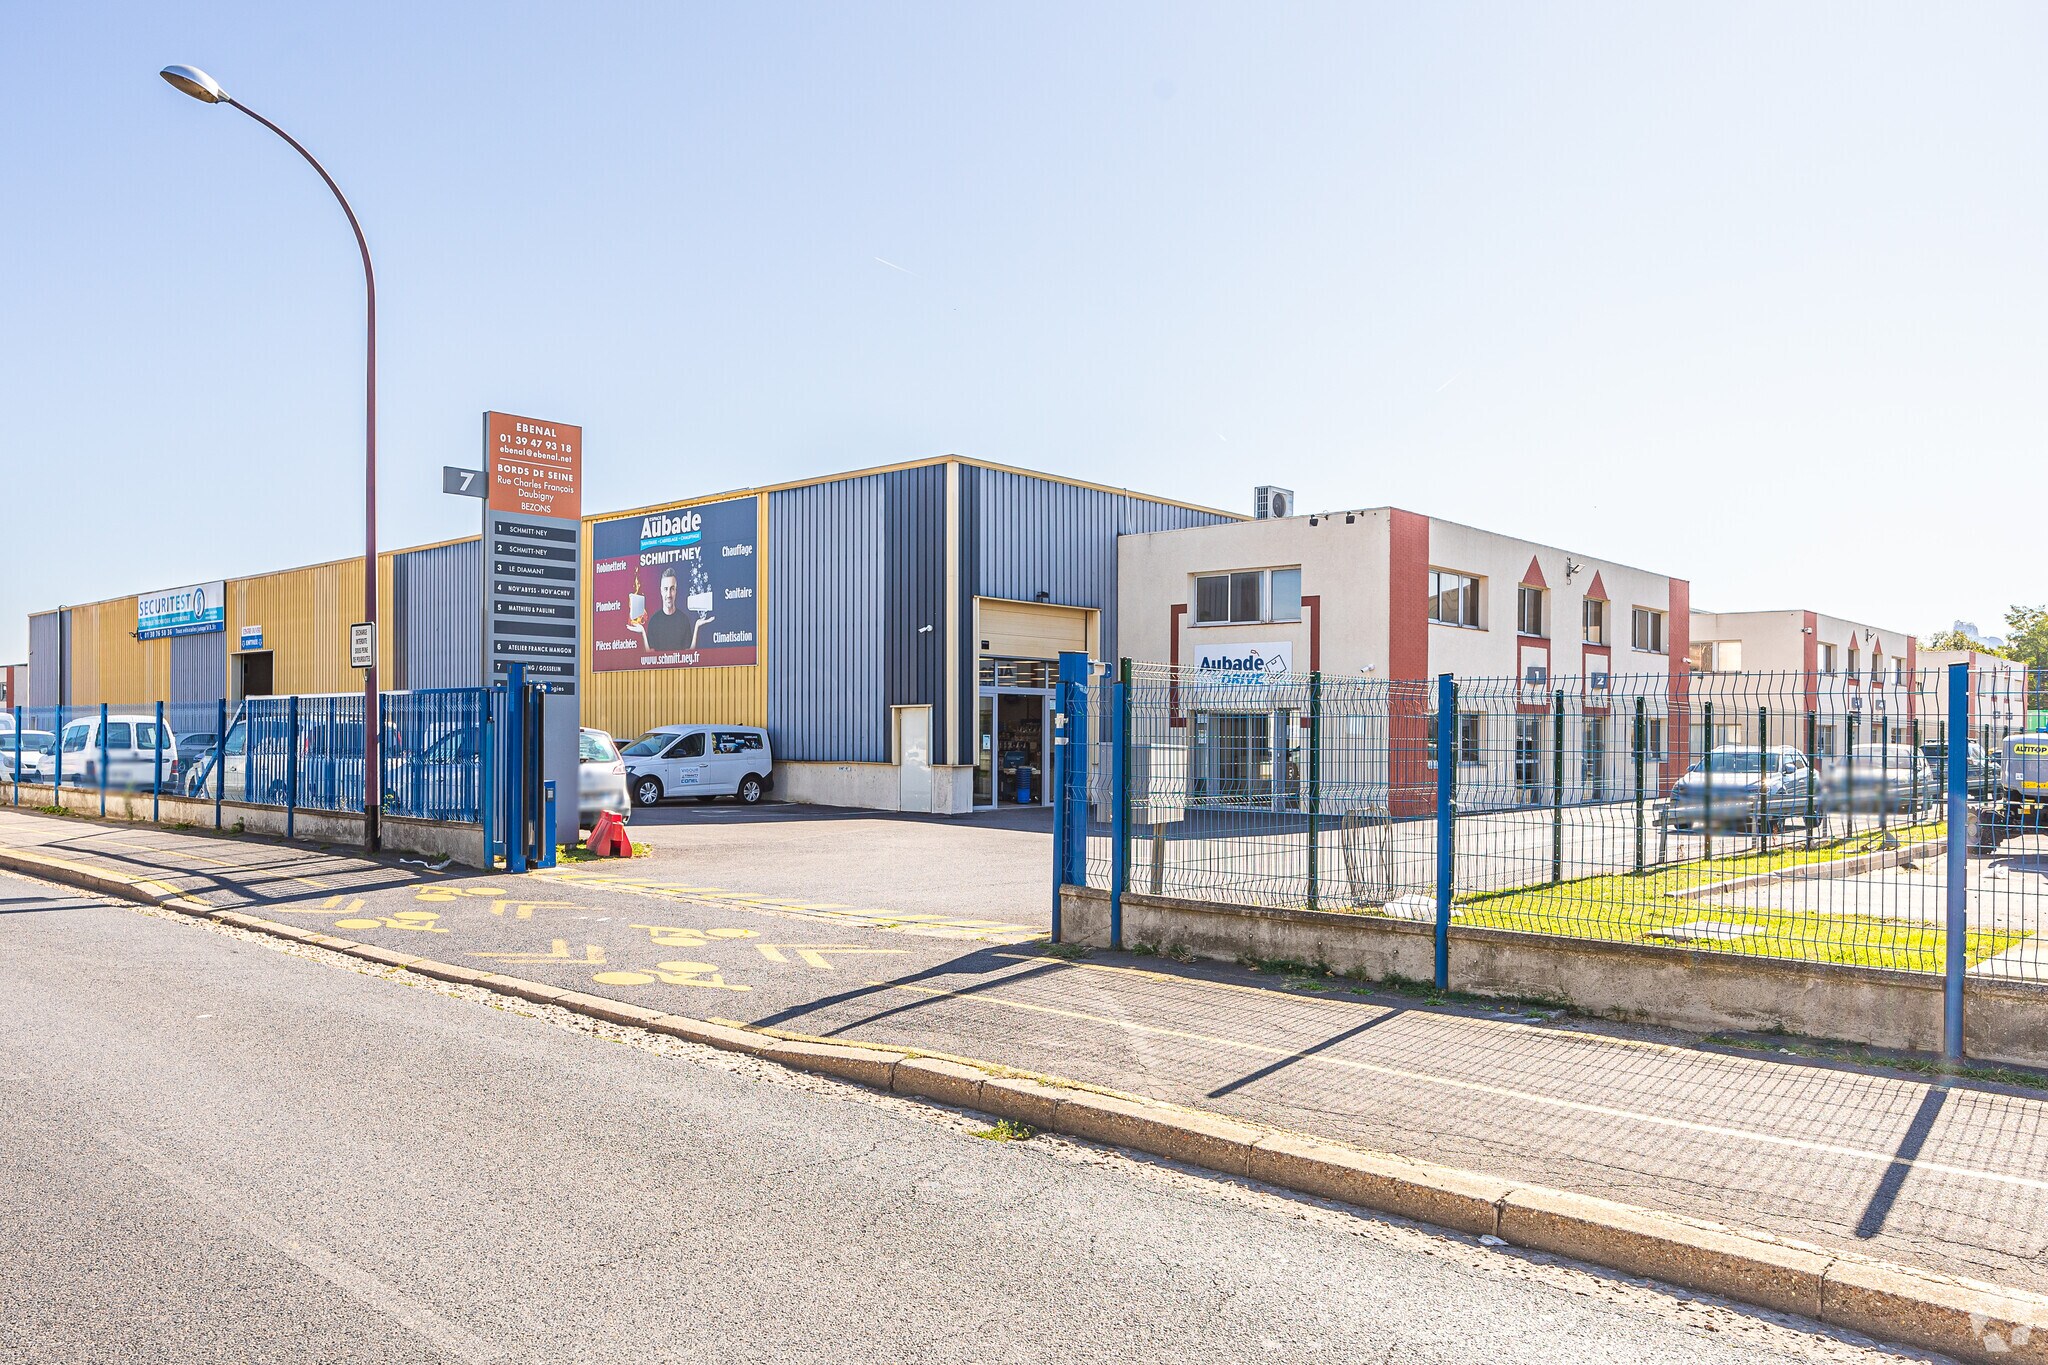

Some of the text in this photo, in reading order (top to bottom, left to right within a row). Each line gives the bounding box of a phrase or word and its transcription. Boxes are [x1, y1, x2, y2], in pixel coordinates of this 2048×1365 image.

[516, 422, 556, 437] EBENAL
[500, 434, 572, 452] 01 39 47 93 18
[500, 445, 572, 462] ebenal@ebenal.net
[498, 464, 573, 481] BORDS DE SEINE
[460, 472, 475, 492] 7
[498, 475, 574, 494] Rue Charles François
[519, 489, 554, 502] Daubigny
[521, 502, 551, 513] BEZONS
[510, 526, 548, 536] SCHMITT-NEY
[641, 511, 701, 539] Aubade
[509, 546, 548, 555] SCHMITT-NEY
[640, 547, 701, 566] SCHMITT-NEY
[722, 544, 752, 557] Chauffage
[596, 560, 626, 573] Robinetterie
[725, 587, 752, 600] Sanitaire
[140, 594, 191, 616] SECURITEST
[596, 600, 621, 612] Plomberie
[713, 631, 752, 643] Climatisation
[596, 638, 637, 650] Pièces détachées
[1200, 655, 1264, 672] Aubade
[1222, 672, 1264, 685] DRIVE
[1535, 671, 1539, 679] 1
[1597, 676, 1604, 685] 2
